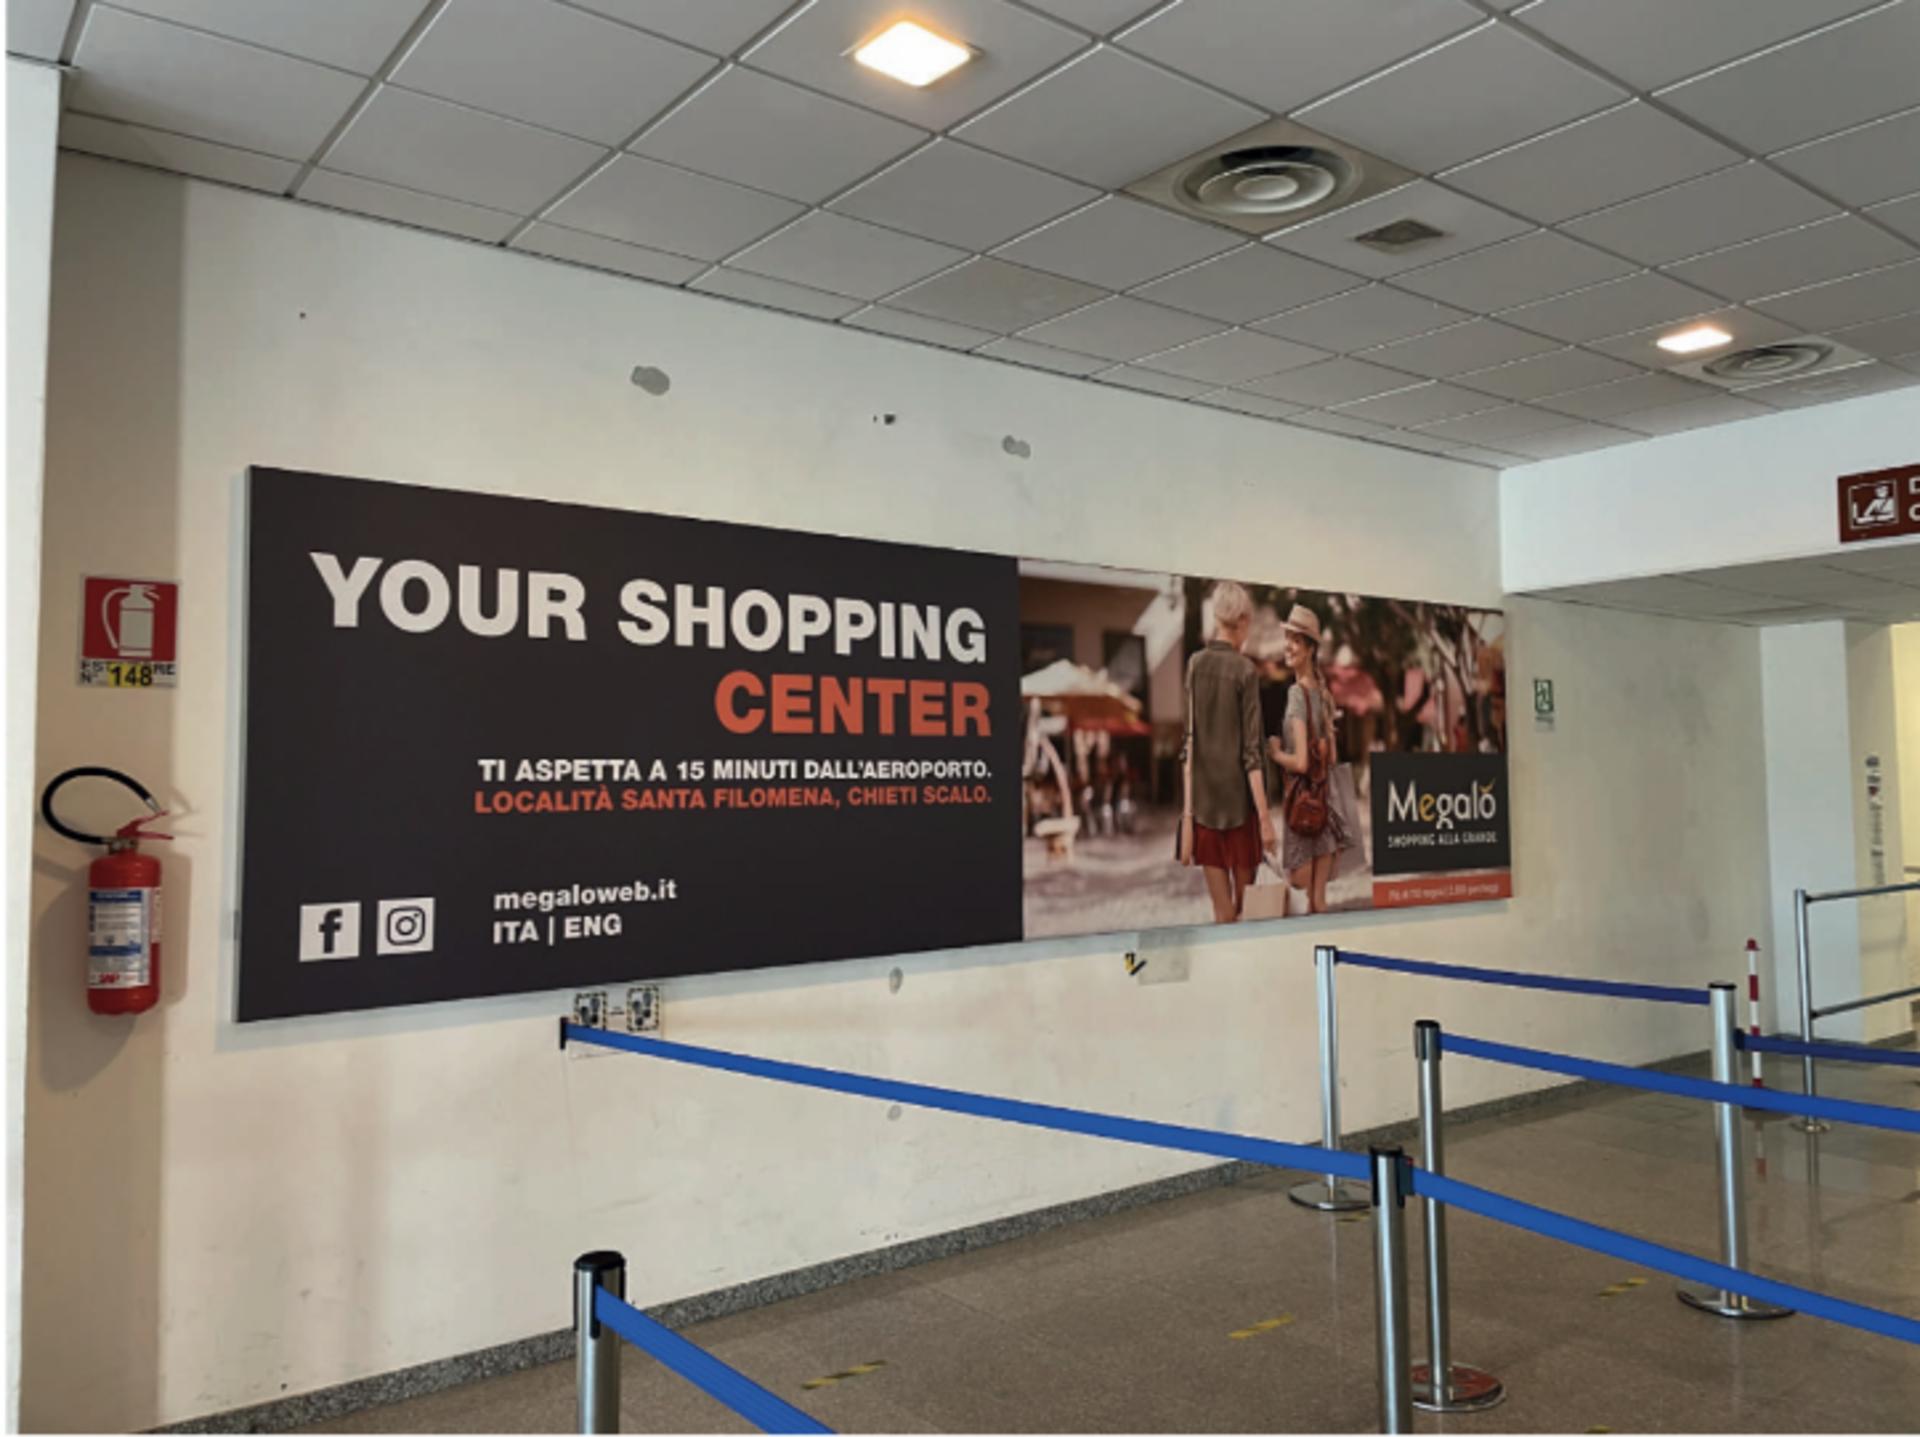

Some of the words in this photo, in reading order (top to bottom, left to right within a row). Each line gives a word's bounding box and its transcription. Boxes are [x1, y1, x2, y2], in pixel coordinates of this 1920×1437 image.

[309, 551, 588, 641] YOUR
[617, 578, 987, 664] SHOPPING
[111, 665, 153, 687] 148
[714, 670, 992, 737] CENTER
[478, 759, 505, 782] TI
[515, 759, 642, 781] ASPETTA
[649, 760, 668, 781] A
[676, 760, 705, 780] 15
[713, 760, 797, 780] MINUTI
[804, 760, 992, 780] DALL'AEROPORTO.
[474, 784, 614, 813] LOCALITÀ
[621, 788, 706, 809] SANTA
[713, 786, 840, 810] FILOMENA,
[847, 786, 917, 805] CHIETI
[923, 785, 992, 804] SCALO.
[1387, 833, 1436, 848] SHOPPING
[494, 878, 678, 911] megaloweb.it
[493, 920, 539, 944] ITA
[564, 913, 622, 938] ENG
